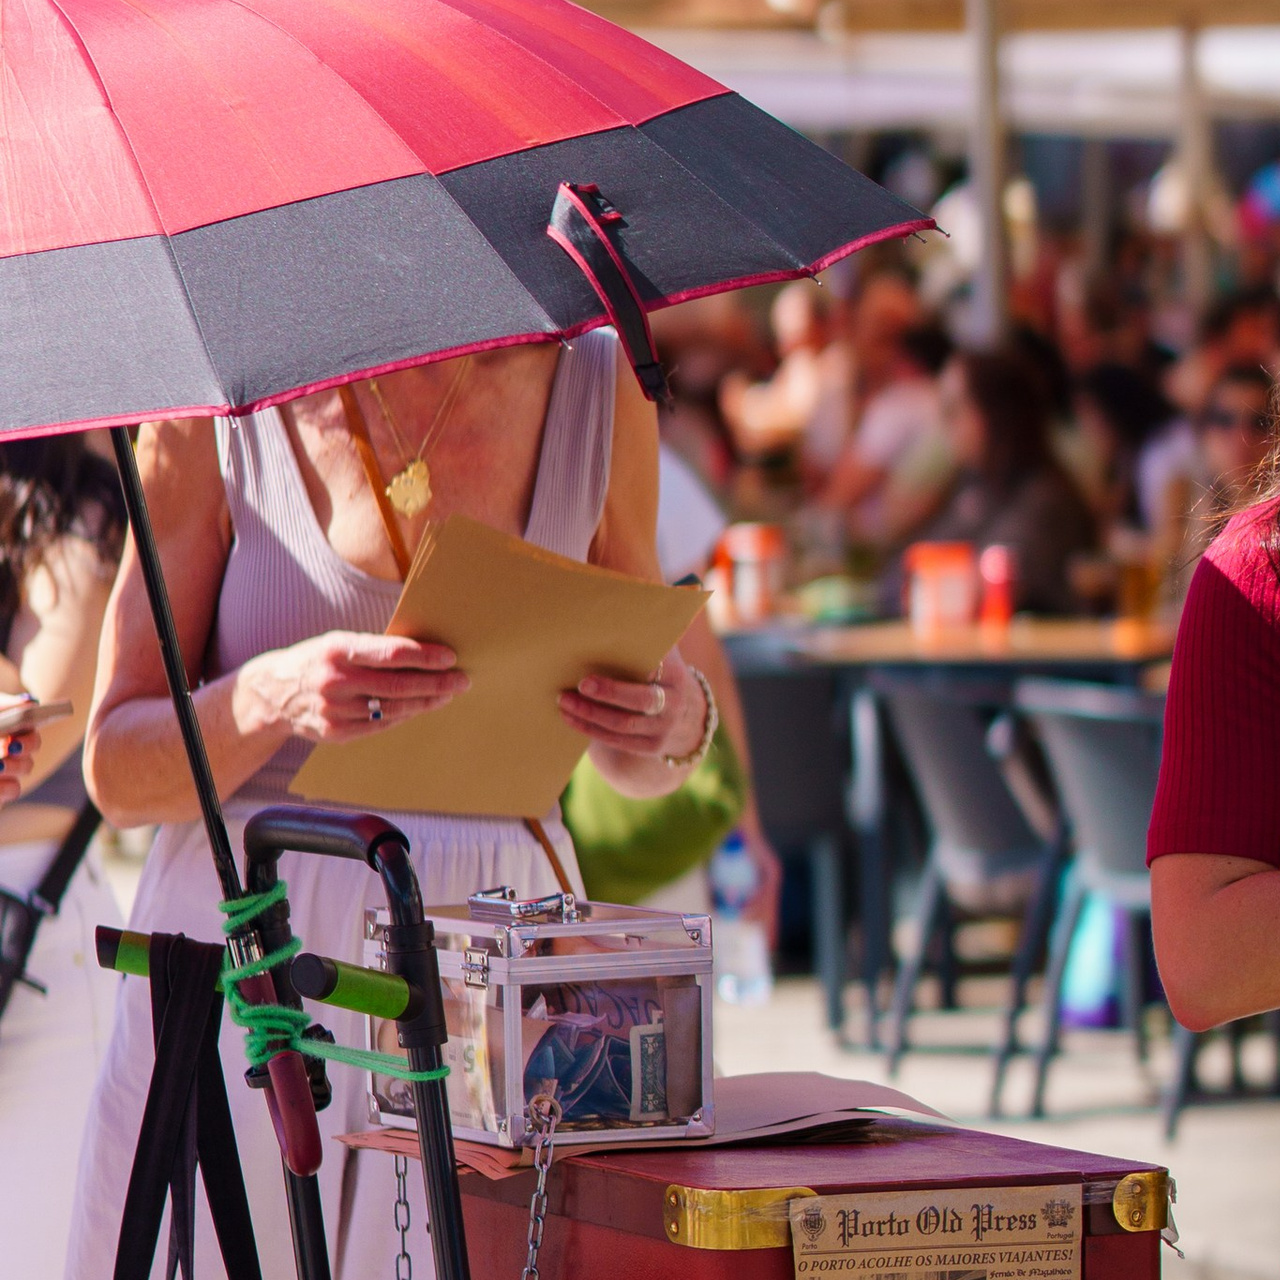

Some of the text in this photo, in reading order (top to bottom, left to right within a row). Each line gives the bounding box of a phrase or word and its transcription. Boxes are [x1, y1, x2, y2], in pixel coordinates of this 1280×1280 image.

[836, 1203, 1037, 1248] Porto Old Press
[1047, 1231, 1074, 1239] Portugal
[798, 1249, 1073, 1272] O PORTO ACOLHE OS MAIORES VIAJANTES!
